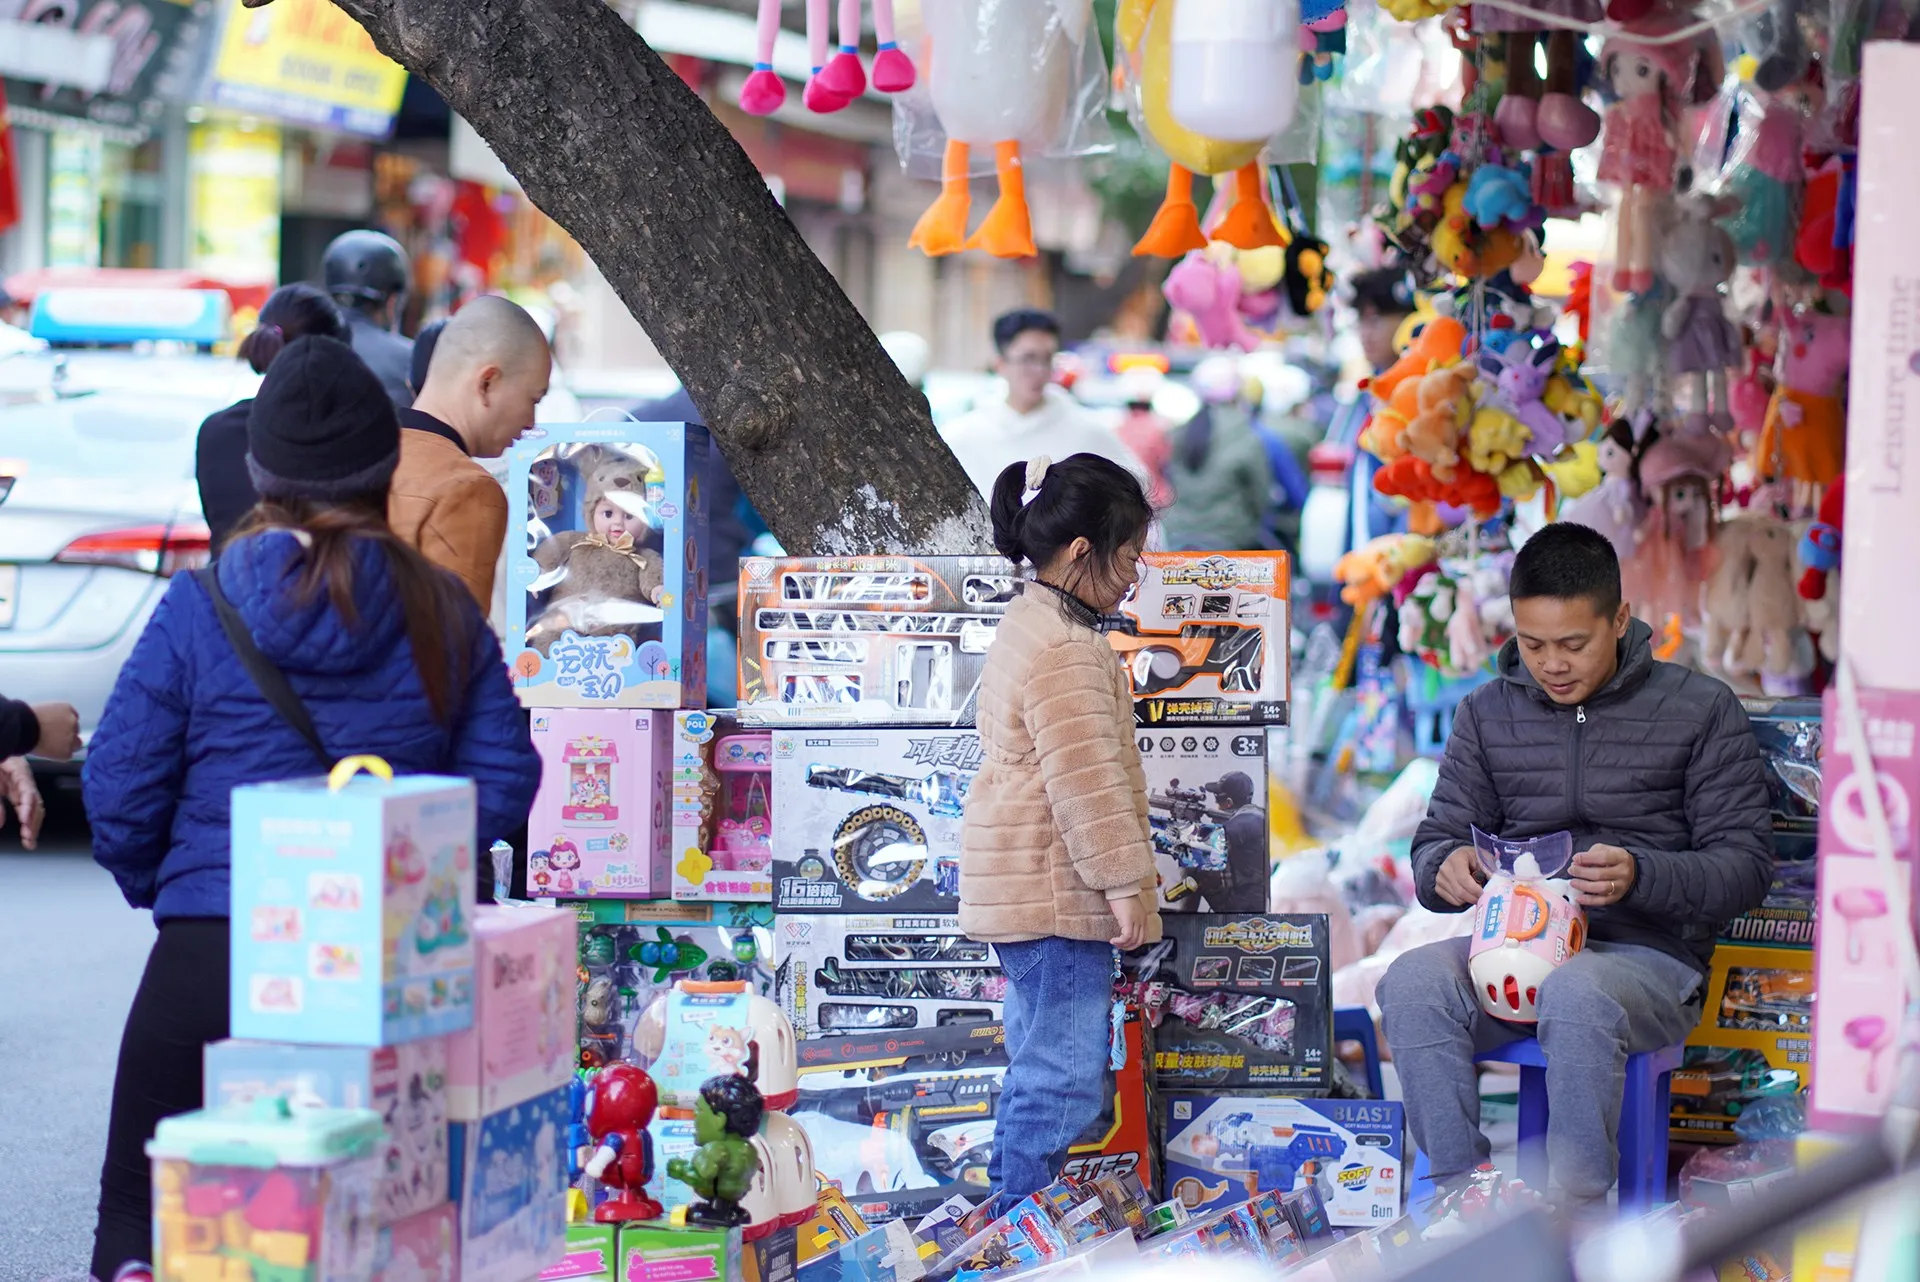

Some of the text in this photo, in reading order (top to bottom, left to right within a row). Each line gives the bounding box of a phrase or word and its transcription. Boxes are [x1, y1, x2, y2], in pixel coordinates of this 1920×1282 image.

[1872, 275, 1911, 497] Leisure time
[577, 669, 622, 700] 宝贝
[686, 720, 706, 729] POLI
[1237, 737, 1259, 754] 3+
[782, 879, 835, 897] 16倍镜
[1731, 918, 1817, 942] DINOSAU
[970, 1026, 999, 1038] BUILD
[1305, 1048, 1322, 1057] 14+
[1333, 1106, 1395, 1122] BLAST
[1337, 1166, 1374, 1183] SOFT
[1343, 1179, 1367, 1188] BULLET
[1371, 1204, 1393, 1218] Gun
